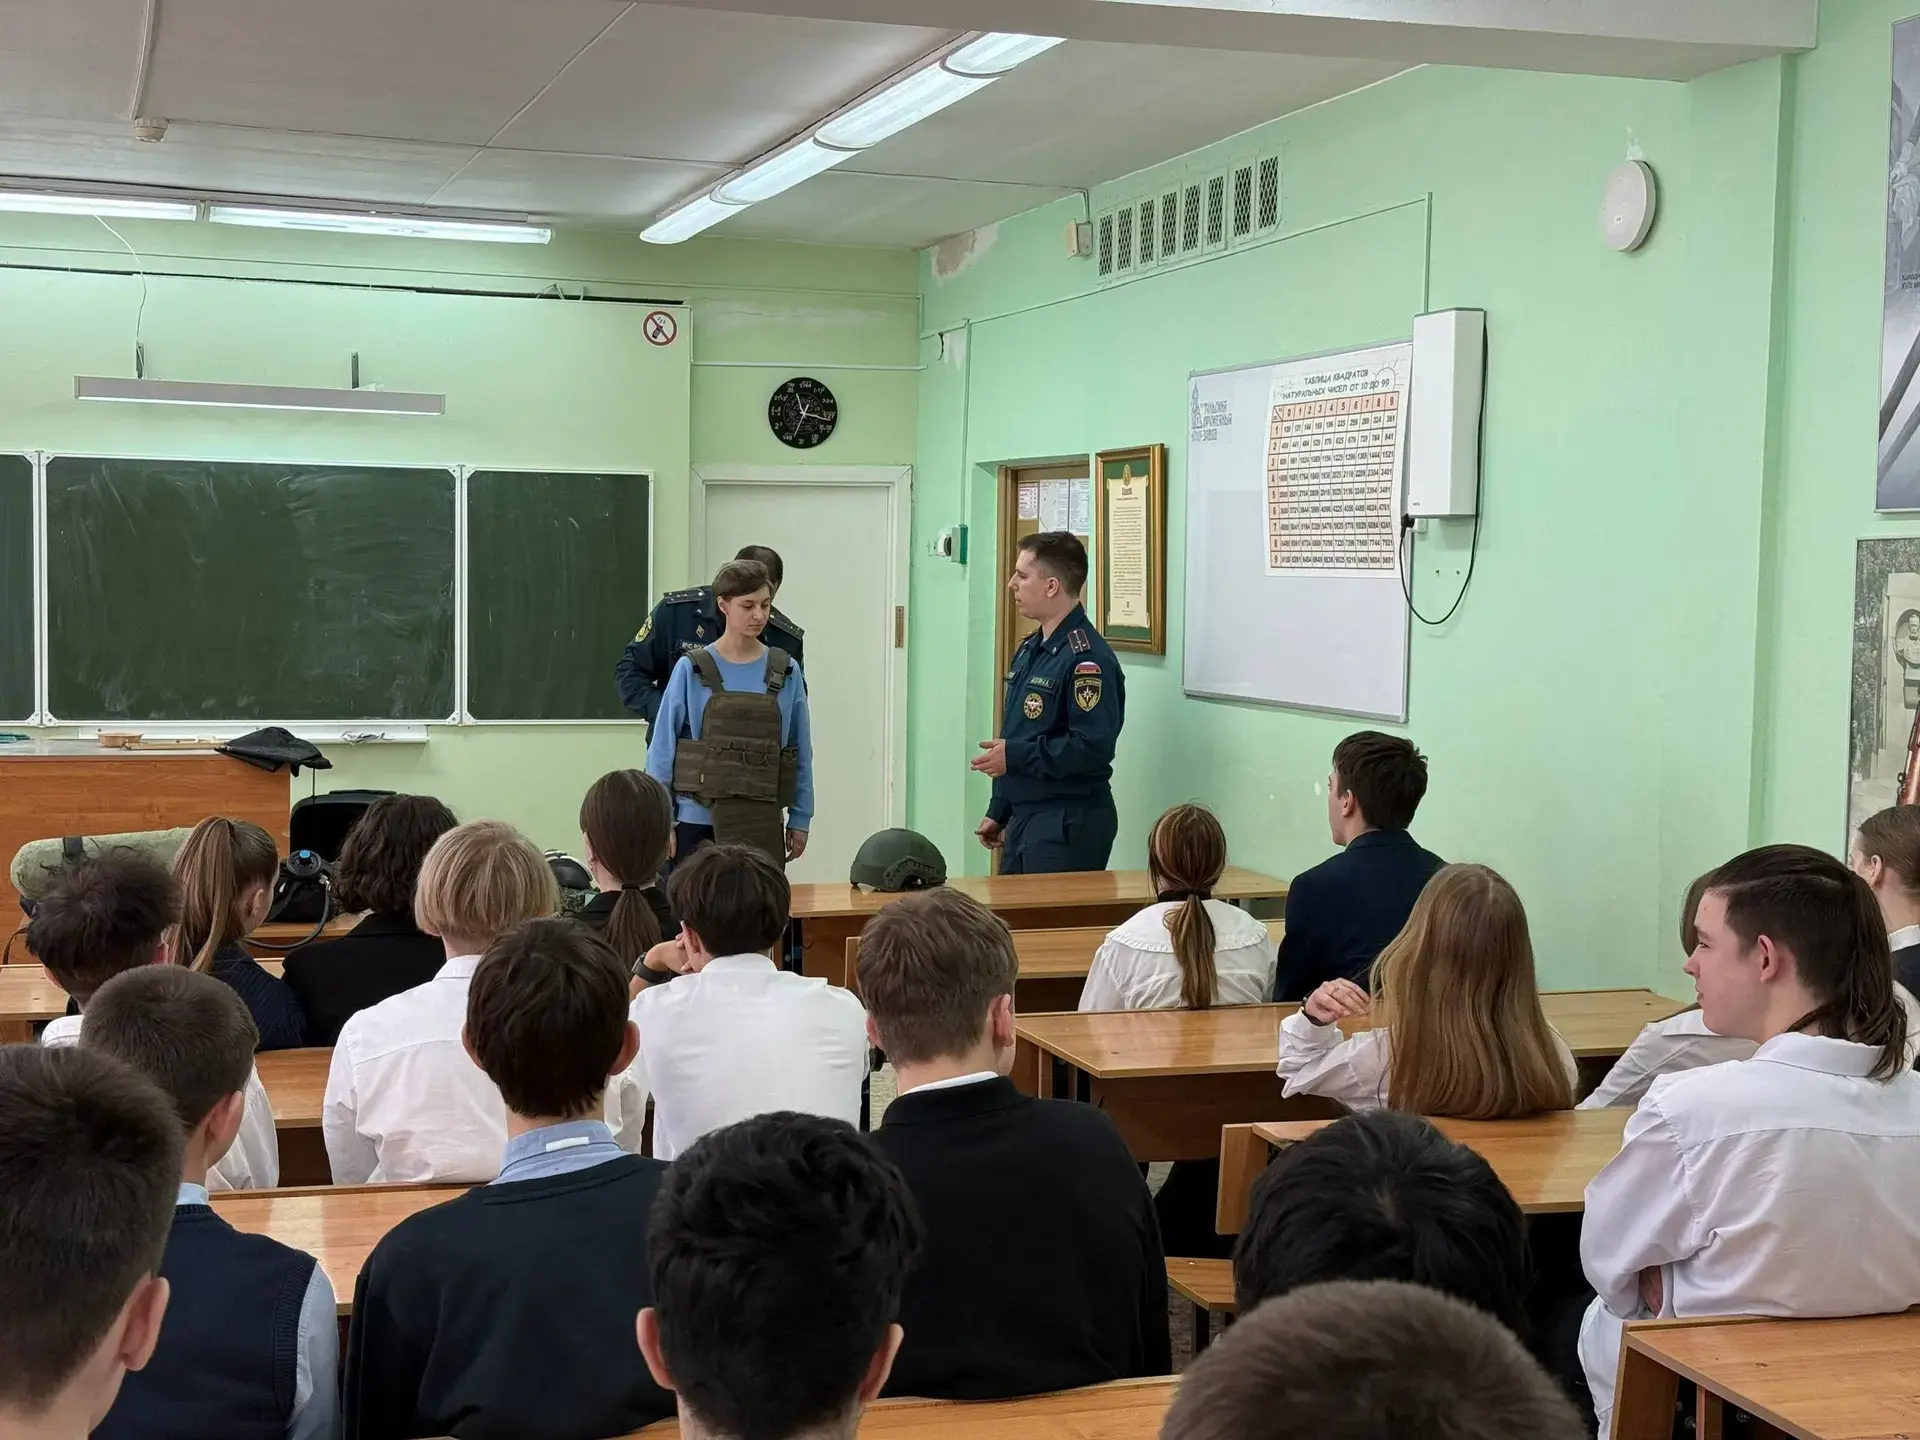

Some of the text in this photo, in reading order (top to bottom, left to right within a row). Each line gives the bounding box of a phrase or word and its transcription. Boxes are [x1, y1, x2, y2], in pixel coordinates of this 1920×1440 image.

[1304, 369, 1368, 385] ТАБЛИЦА КВАДРАТОВ
[1283, 387, 1326, 400] НАТУРАЛЬНЫХ
[1328, 384, 1347, 393] ЧИСЕЛ
[1350, 383, 1359, 391] ОТ
[1370, 380, 1379, 389] ДО
[1381, 378, 1390, 387] 99
